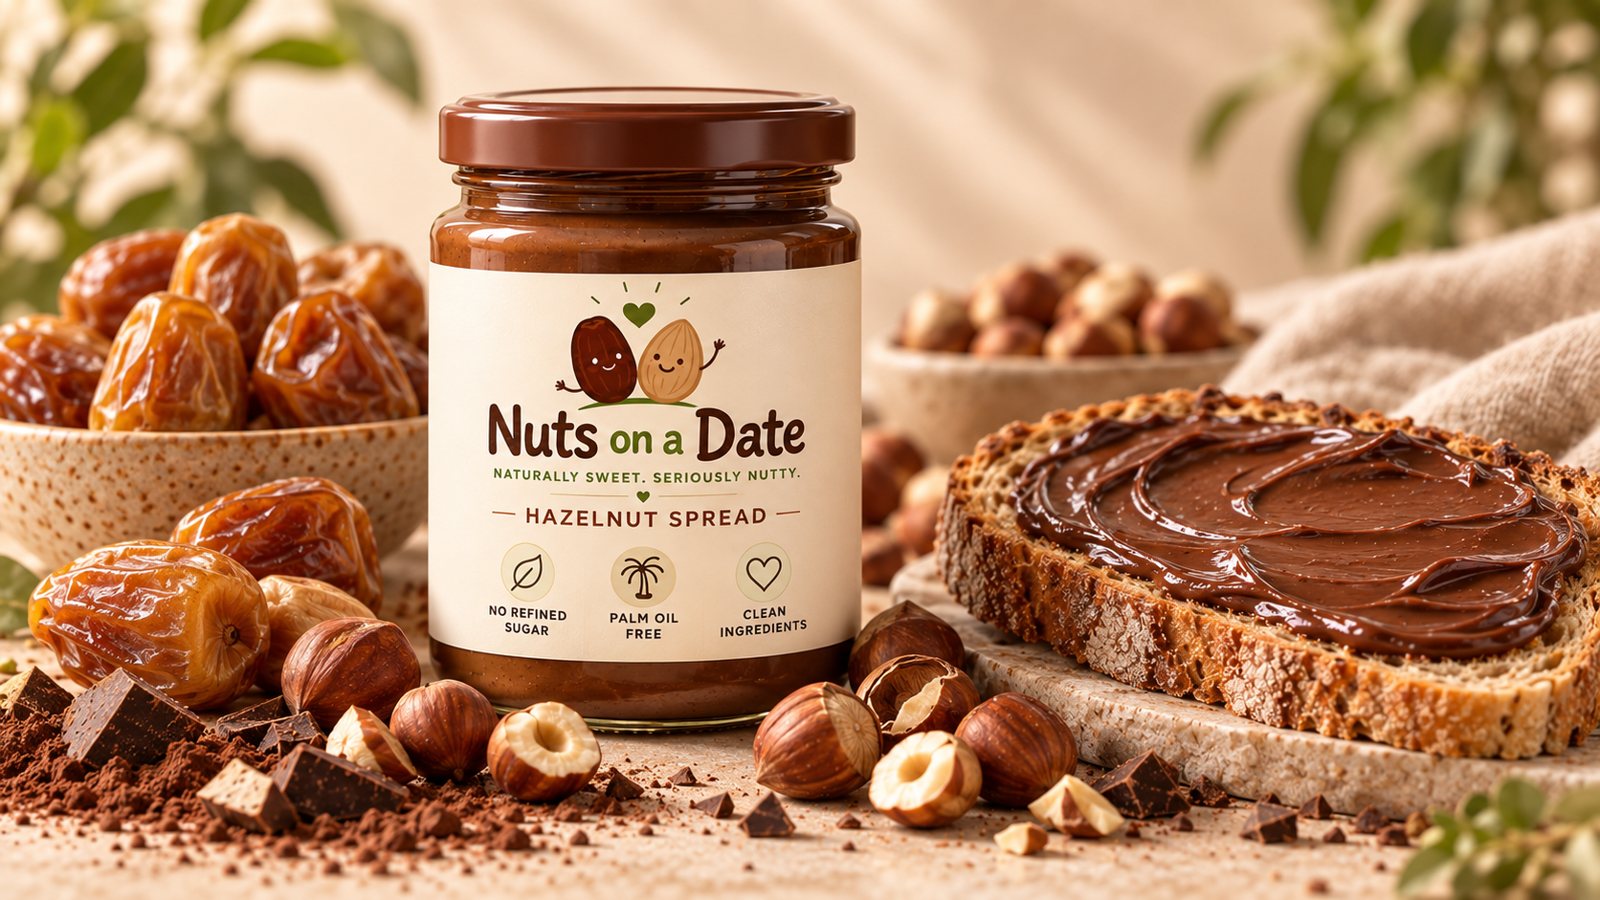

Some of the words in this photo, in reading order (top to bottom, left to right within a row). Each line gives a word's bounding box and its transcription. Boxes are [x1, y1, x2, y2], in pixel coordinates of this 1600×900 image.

[488, 404, 598, 459] Nuts
[610, 431, 652, 454] on
[663, 431, 684, 455] a
[696, 408, 805, 461] Date
[494, 468, 578, 482] NATURALLY
[586, 472, 645, 483] SWEET.
[654, 471, 740, 483] SERIOUSLY
[749, 468, 800, 480] NUTTY.
[527, 508, 657, 527] HAZELNUT
[669, 508, 766, 527] SPREAD
[489, 605, 506, 616] NO
[511, 607, 566, 620] REFINED
[610, 613, 648, 623] PALM
[655, 613, 678, 623] OIL
[743, 606, 785, 619] CLEAN
[505, 622, 548, 636] SUGAR
[626, 629, 661, 639] FREE
[720, 620, 807, 638] INGREDIENTS
